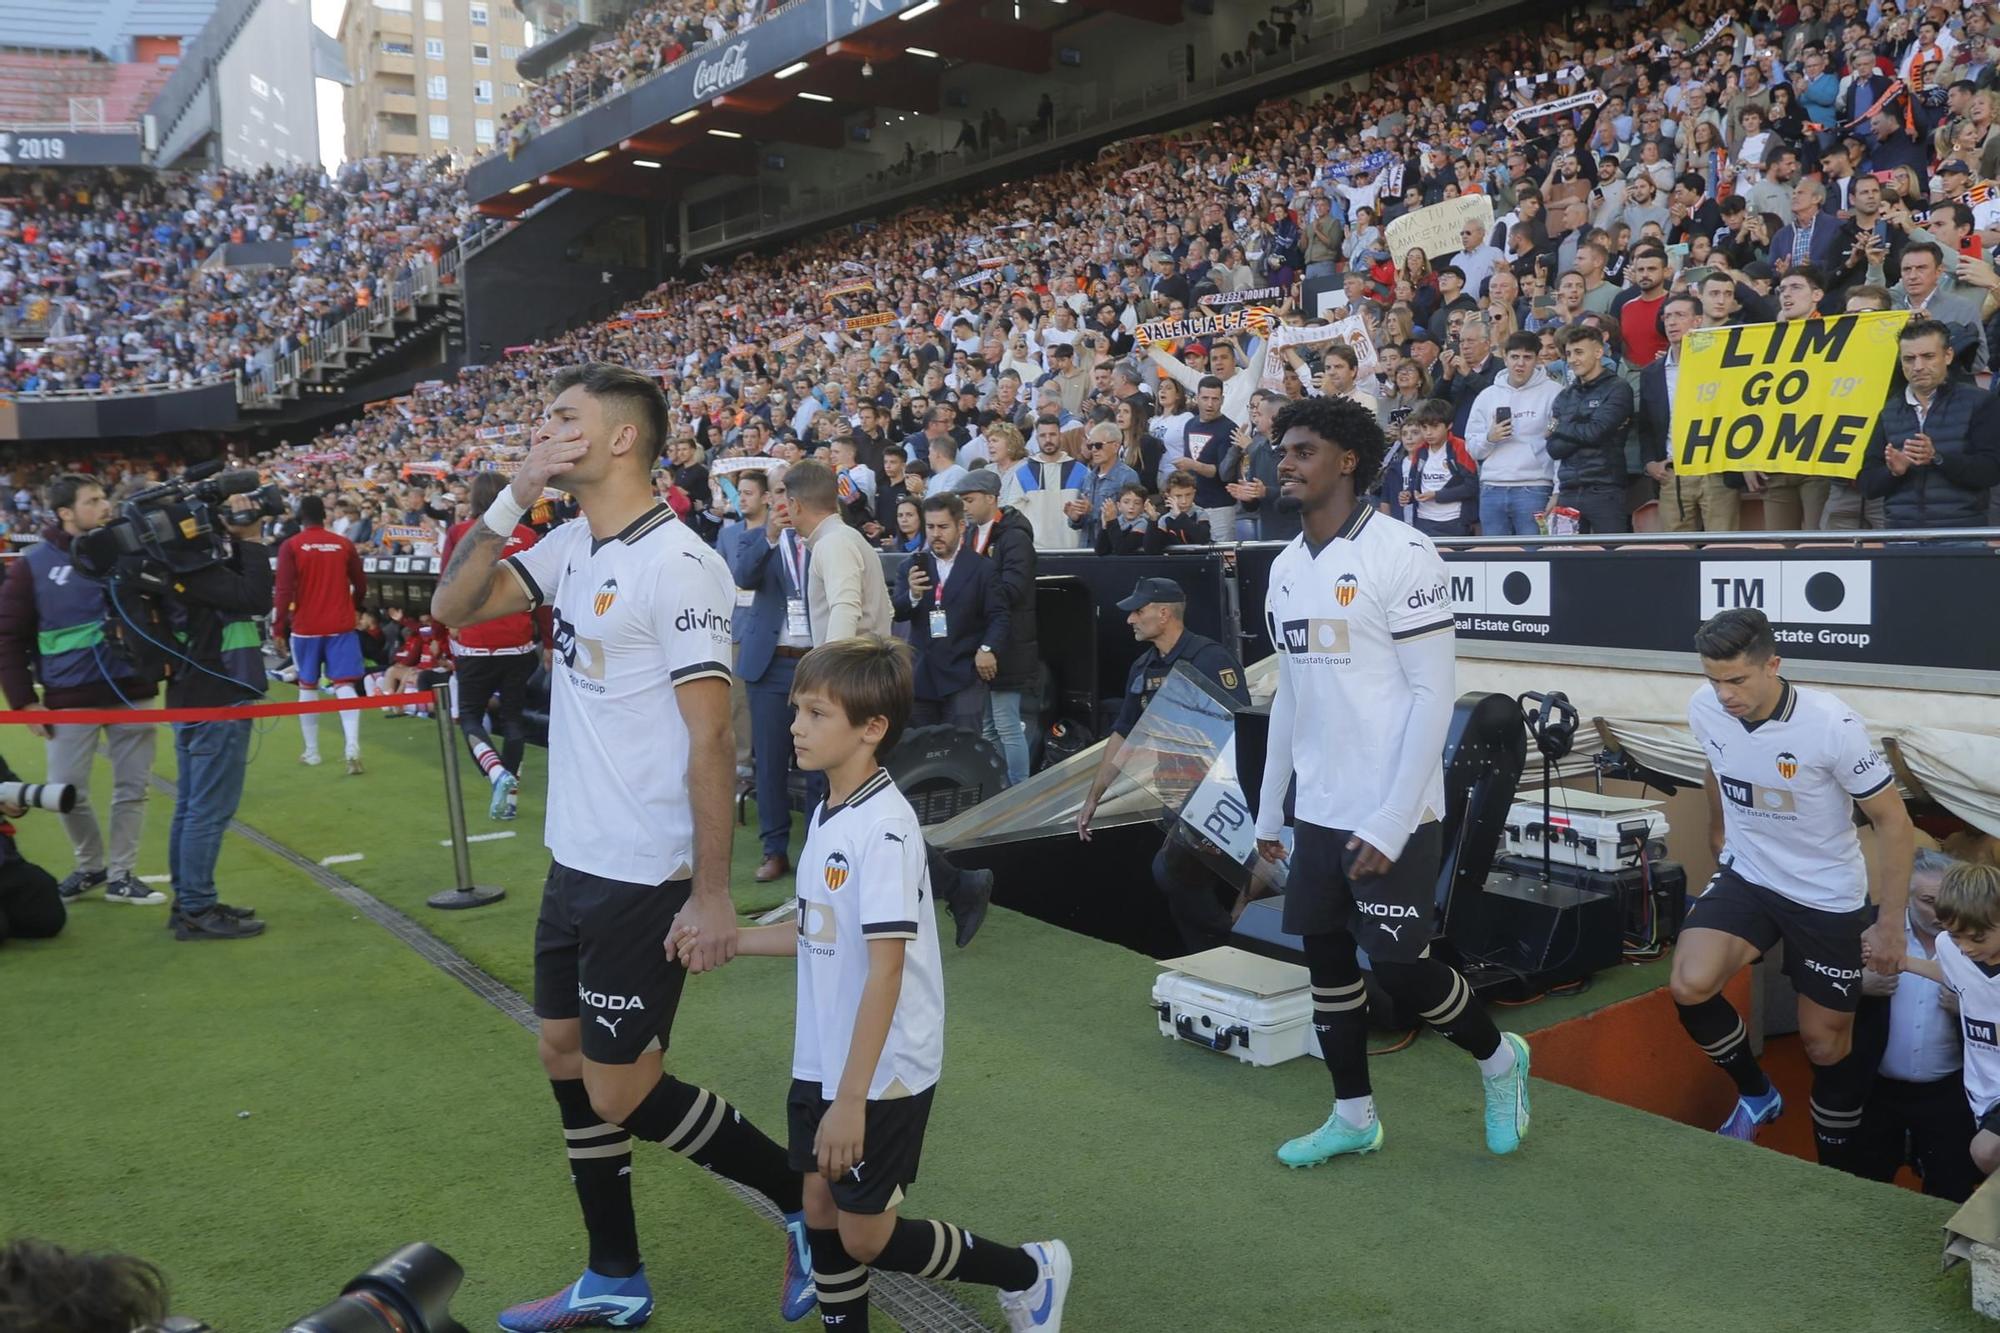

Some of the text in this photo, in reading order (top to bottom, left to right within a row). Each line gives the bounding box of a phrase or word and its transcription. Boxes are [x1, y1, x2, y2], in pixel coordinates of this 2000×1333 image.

[17, 137, 65, 160] 2019
[1142, 314, 1217, 341] VALENCIA
[1720, 315, 1859, 368] LIM
[1741, 369, 1810, 407] GO
[1681, 413, 1869, 465] HOME
[1407, 583, 1449, 610] divin
[1451, 576, 1474, 602] M
[1711, 578, 1764, 609] TM
[1286, 628, 1306, 647] TM
[1455, 618, 1550, 636] eal Estate Group
[1773, 629, 1870, 648] state Group
[1324, 655, 1352, 666] Group
[580, 679, 606, 695] Group
[1723, 782, 1747, 802] TM
[1746, 809, 1770, 819] Estate
[1771, 813, 1798, 822] Group
[1967, 1022, 1991, 1041] TM
